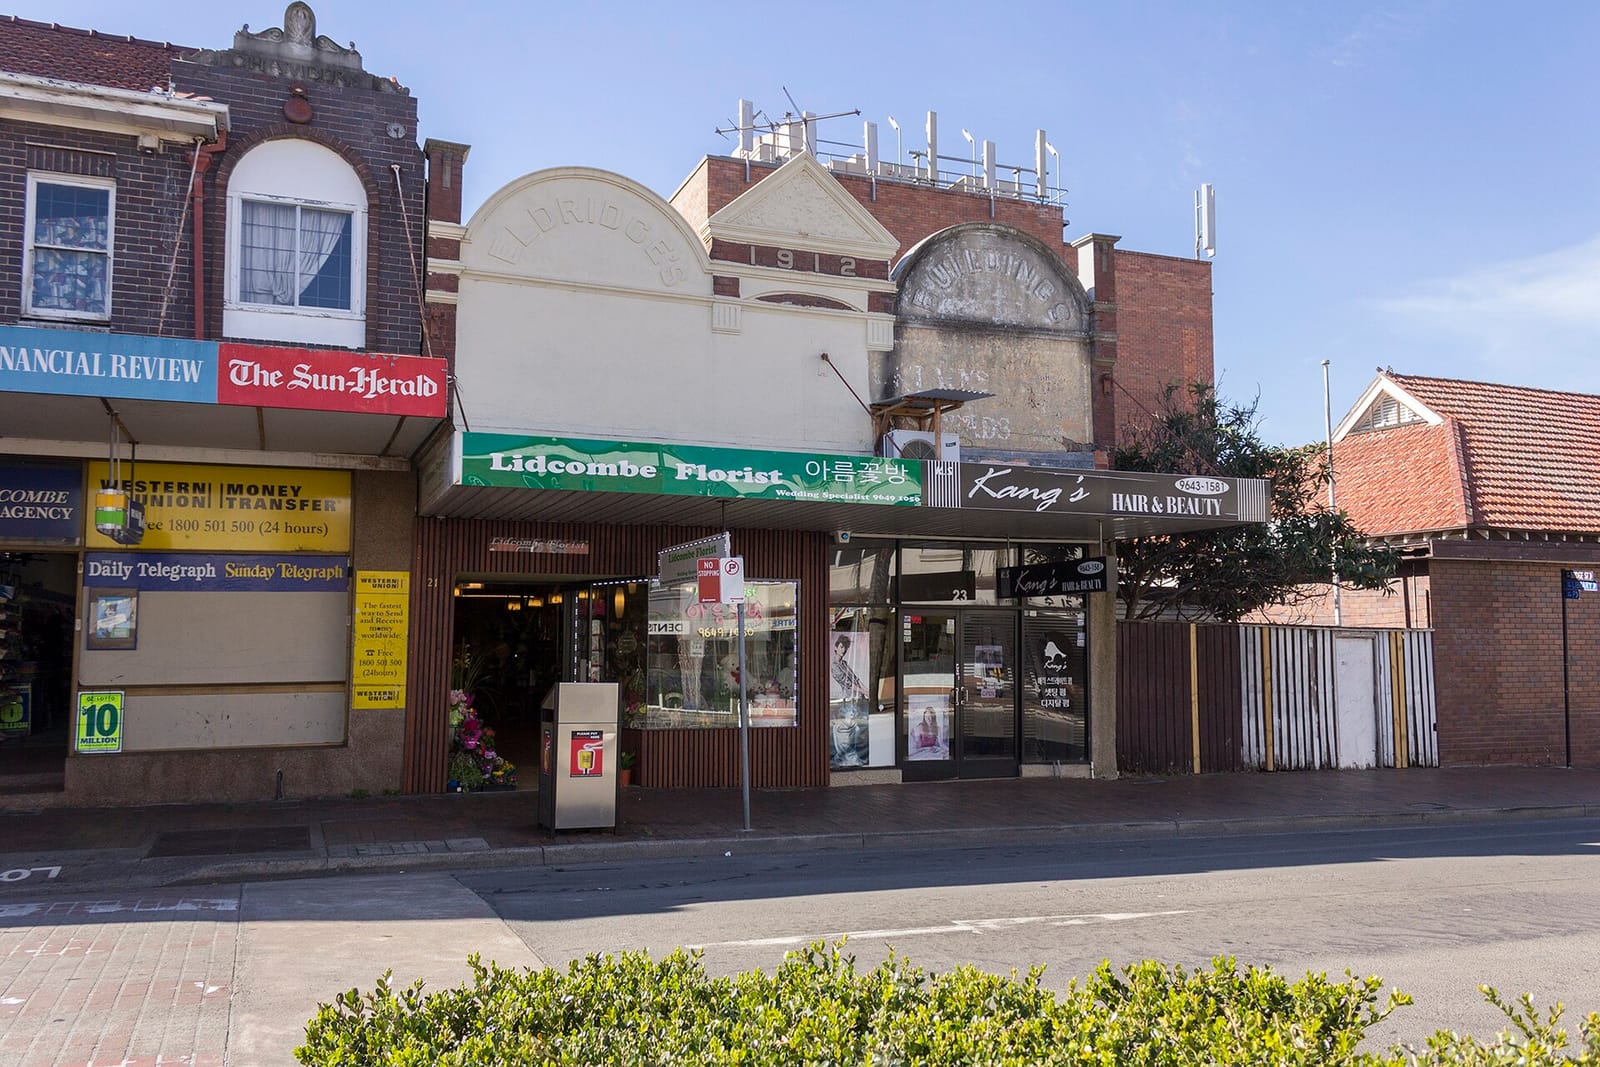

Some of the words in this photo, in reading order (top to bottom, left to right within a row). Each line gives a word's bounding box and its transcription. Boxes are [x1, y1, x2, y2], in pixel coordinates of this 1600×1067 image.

[750, 246, 857, 277] 1912
[109, 353, 205, 384] REVIEW
[228, 358, 284, 387] The
[286, 363, 439, 399] Sun-Herald
[489, 452, 657, 478] Lidcombe
[674, 462, 783, 485] Florist
[805, 460, 909, 485] 아름꽃방
[100, 479, 206, 495] WESTERN
[226, 483, 303, 498] MONEY
[776, 488, 819, 499] Wedding
[822, 491, 871, 501] Specialist
[873, 493, 896, 502] 9649
[968, 467, 1091, 511] Kang's
[1178, 480, 1226, 492] 9643-1581
[0, 489, 69, 504] COMBE
[135, 493, 206, 509] UNION
[226, 496, 336, 512] TRANSFER
[1111, 493, 1149, 513] HAIR
[1151, 496, 1164, 513] &
[1165, 496, 1222, 516] BEAUTY
[0, 506, 74, 520] AGENCY
[169, 518, 199, 532] 1800
[203, 519, 226, 533] 501
[231, 520, 255, 533] 500
[258, 520, 281, 537] (24
[285, 521, 329, 538] hours)
[88, 561, 133, 581] Daily
[137, 562, 217, 581] Telegraph
[224, 562, 275, 581] Sunday
[276, 563, 344, 581] Telegraph
[703, 561, 714, 569] NO
[427, 577, 438, 588] 21
[1014, 569, 1058, 595] Kang's
[952, 589, 968, 601] 23
[364, 601, 377, 609] The
[379, 601, 402, 609] fastest
[385, 609, 403, 617] Send
[698, 627, 724, 638] 9649
[377, 649, 394, 657] Free
[80, 737, 117, 745] MILLION
